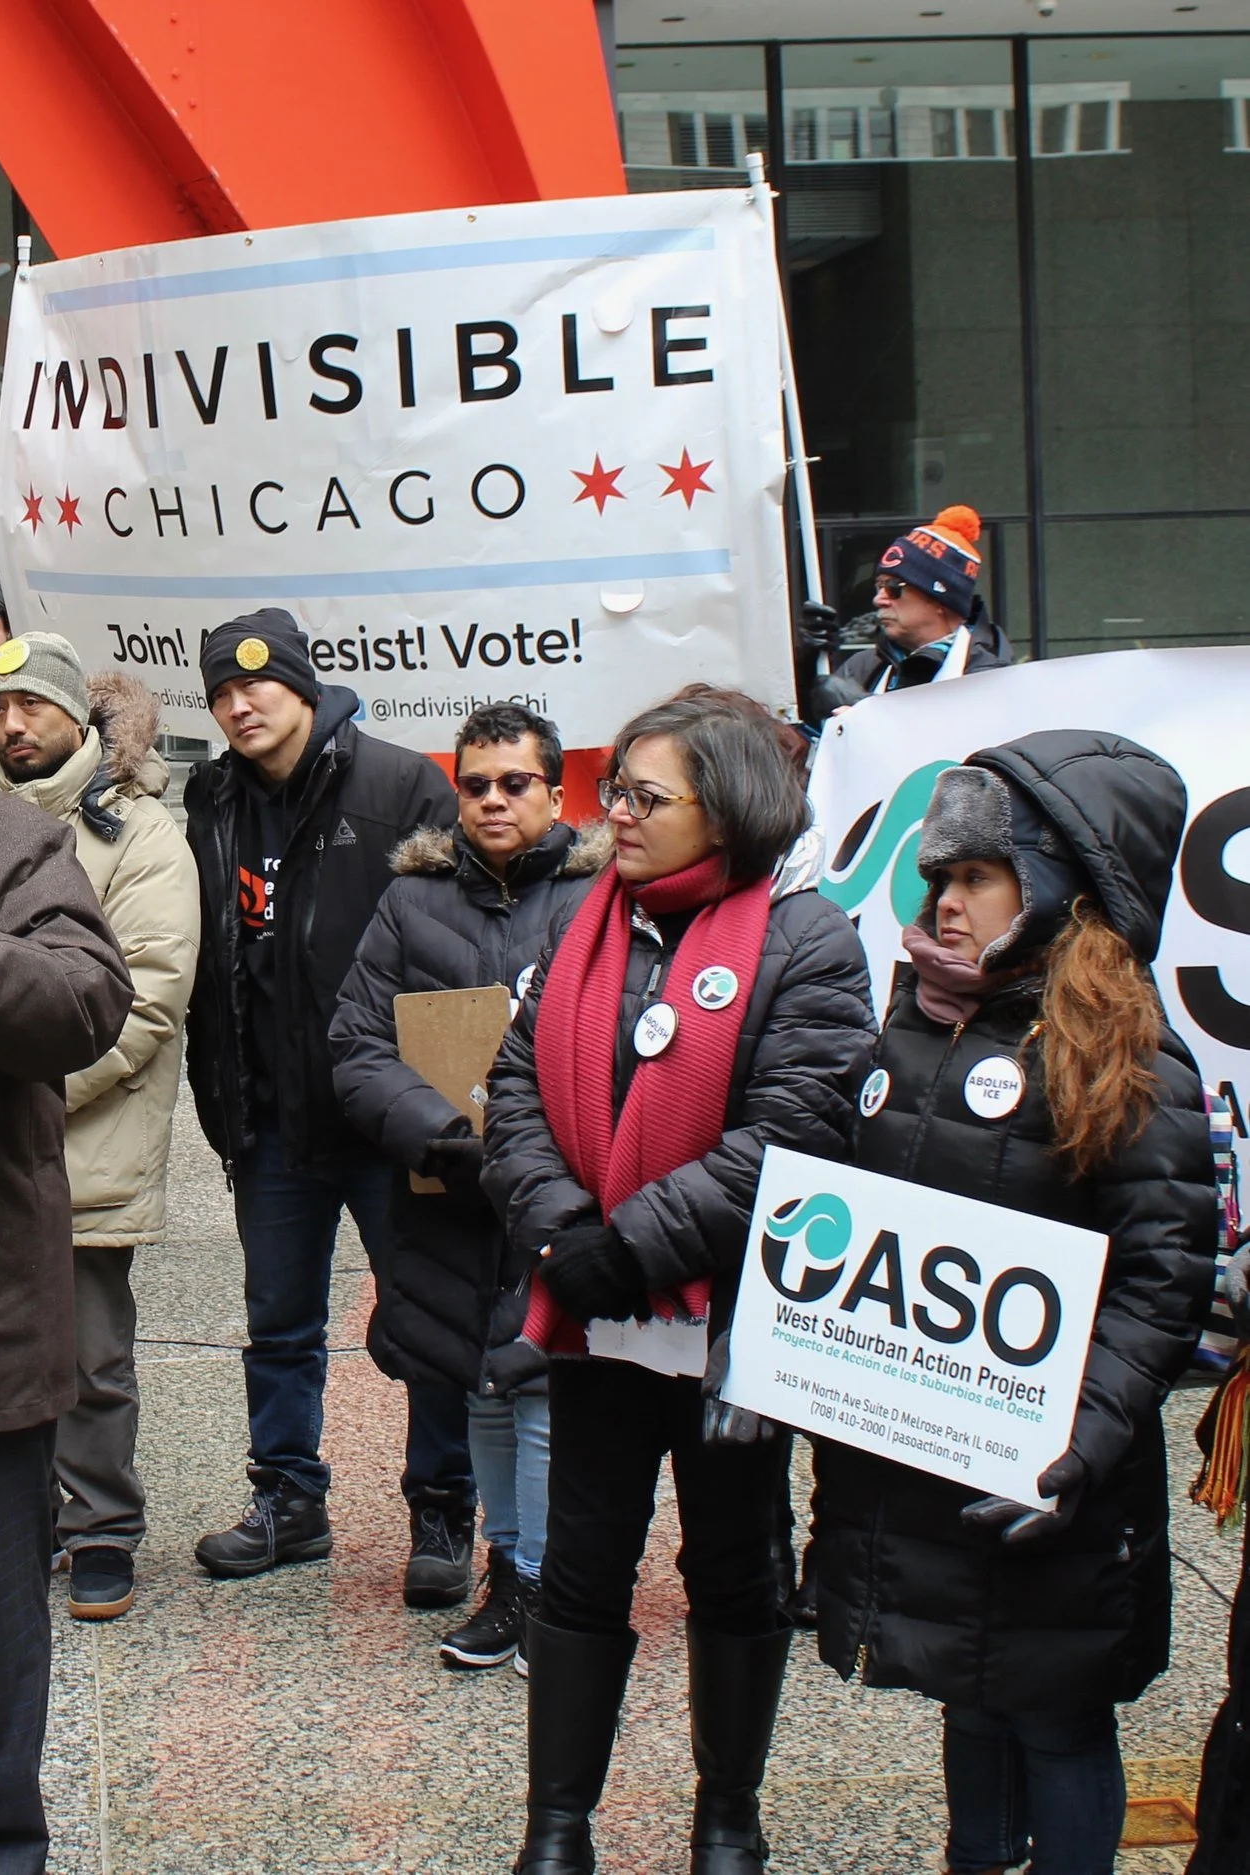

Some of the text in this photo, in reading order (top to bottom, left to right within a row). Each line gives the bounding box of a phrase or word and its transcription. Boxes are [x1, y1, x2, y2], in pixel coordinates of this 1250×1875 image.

[22, 303, 715, 430] INDIVISIBLE
[104, 463, 526, 538] CHICAGO
[107, 622, 189, 667] Join!
[311, 625, 428, 671] esist!
[440, 618, 583, 668] Vote!
[152, 688, 206, 709] ndivisib
[371, 693, 548, 721] @Indivisiblhi
[968, 1076, 1019, 1091] ABOLISH
[983, 1089, 1001, 1100] ICE
[772, 1327, 1044, 1423] Proyecto de Acción de los Suburbios del Oeste
[776, 1303, 1047, 1406] West Suburban Action Project
[774, 1369, 1019, 1462] 3415 W North Ave Suite D Melrose Park IL 60160
[810, 1400, 837, 1421] (708)
[838, 1410, 886, 1437] 410-2000
[892, 1429, 971, 1468] pasoaction.org
